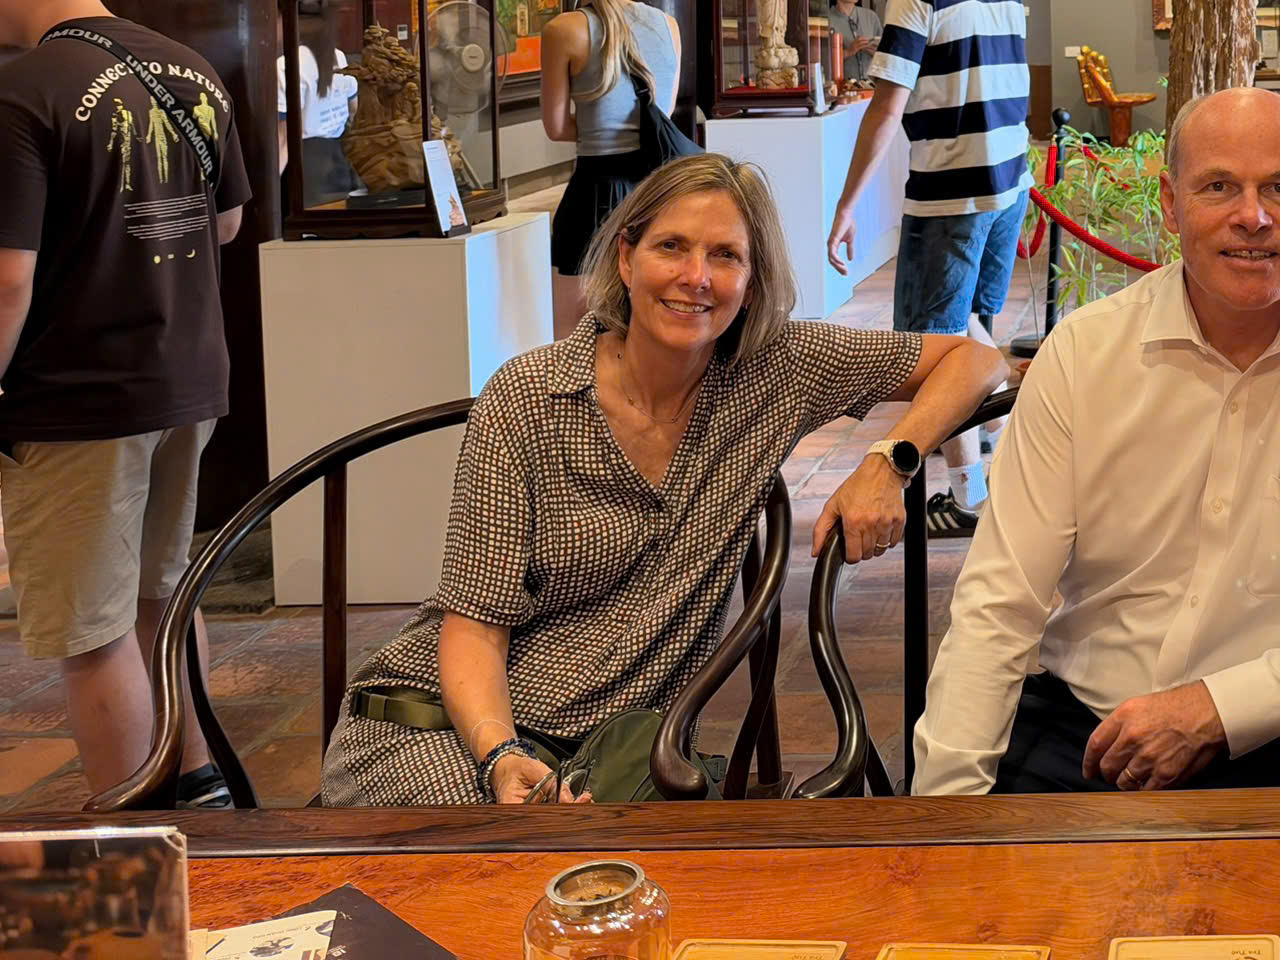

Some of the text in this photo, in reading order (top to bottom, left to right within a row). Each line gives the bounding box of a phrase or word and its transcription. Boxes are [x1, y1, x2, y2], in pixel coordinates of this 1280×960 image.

[126, 54, 214, 175] UNDER ARMOUR
[168, 63, 229, 113] NATURE
